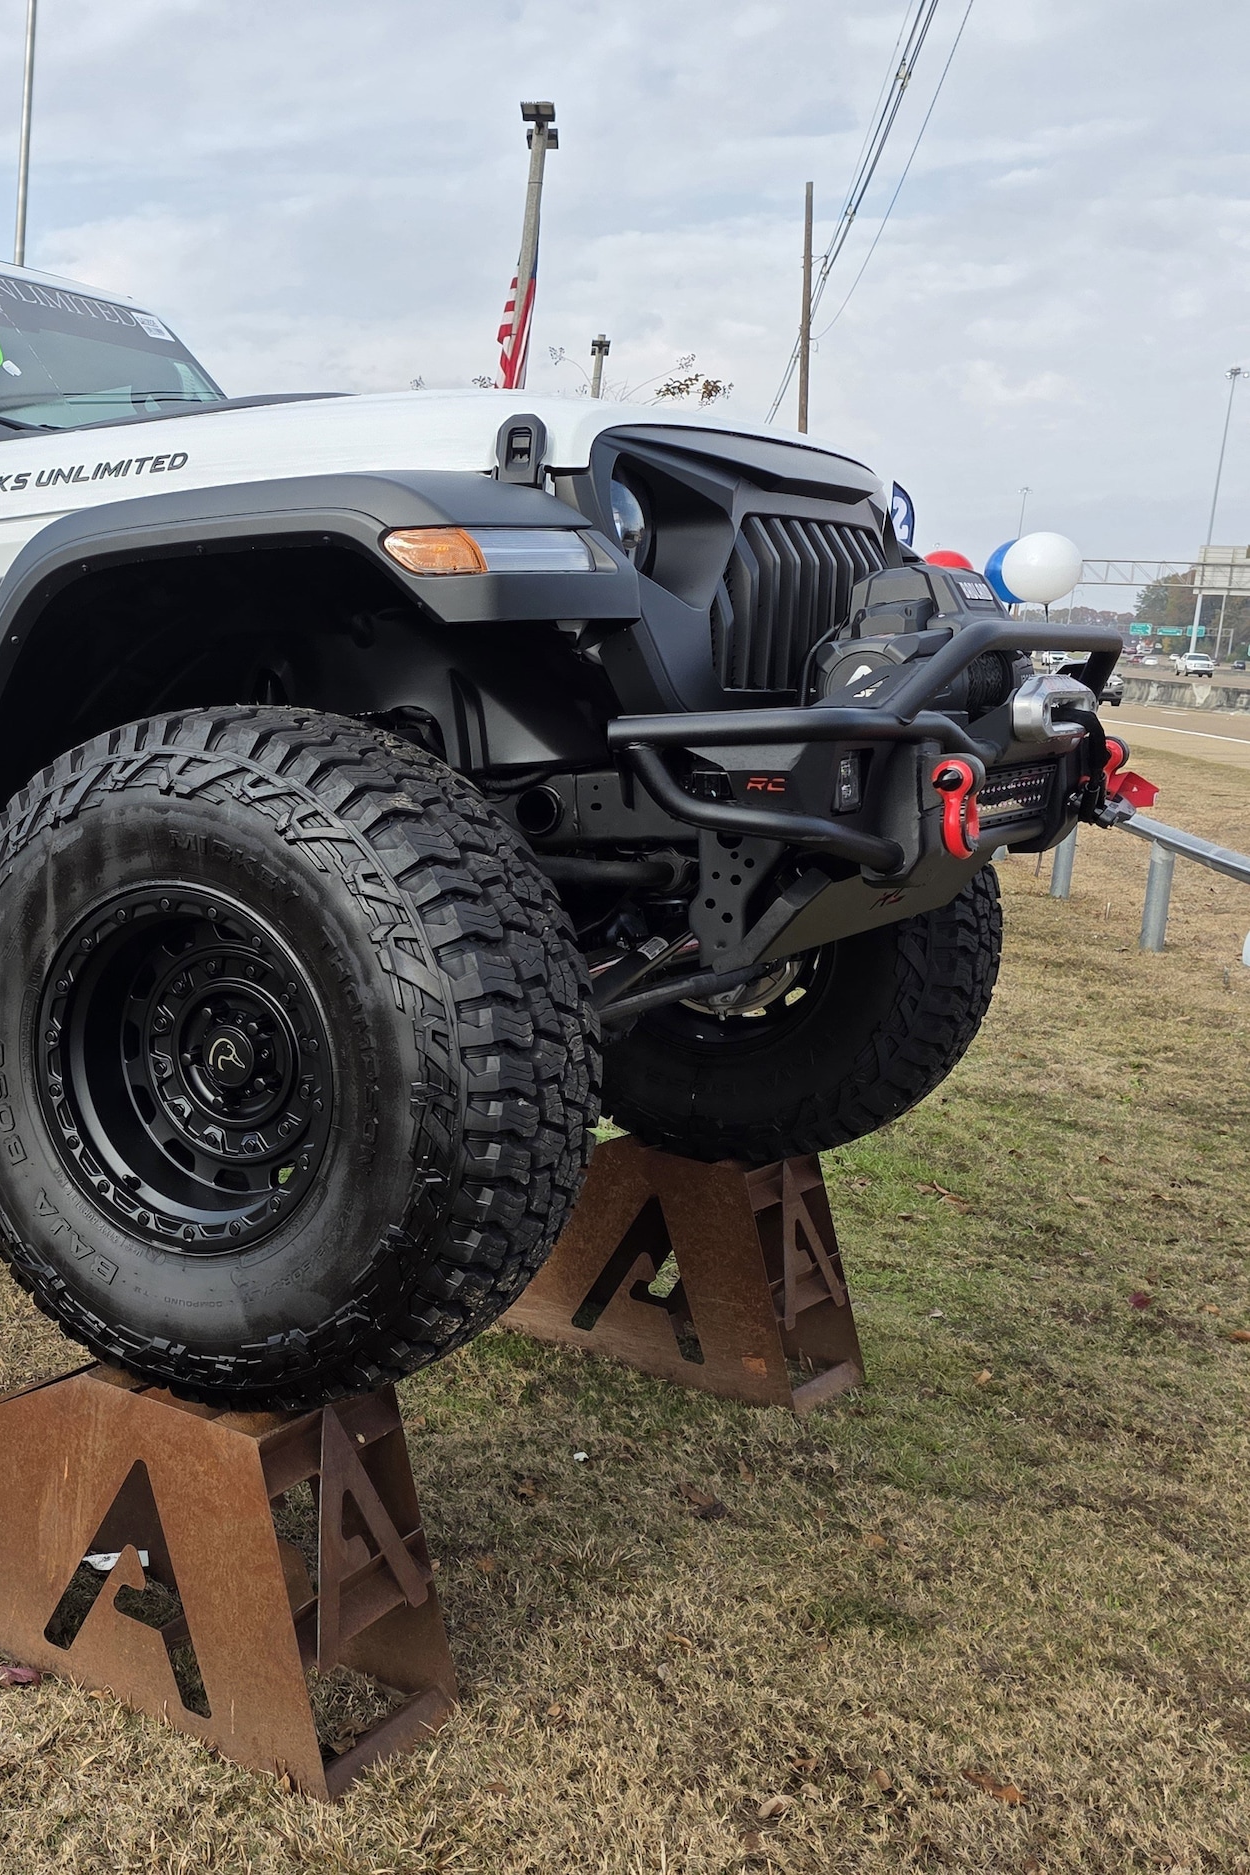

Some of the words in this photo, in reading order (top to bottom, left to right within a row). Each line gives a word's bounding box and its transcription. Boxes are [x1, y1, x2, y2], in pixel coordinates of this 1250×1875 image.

[35, 452, 189, 488] UNLIMITED
[746, 777, 786, 792] RC
[33, 1187, 121, 1287] BAJA
